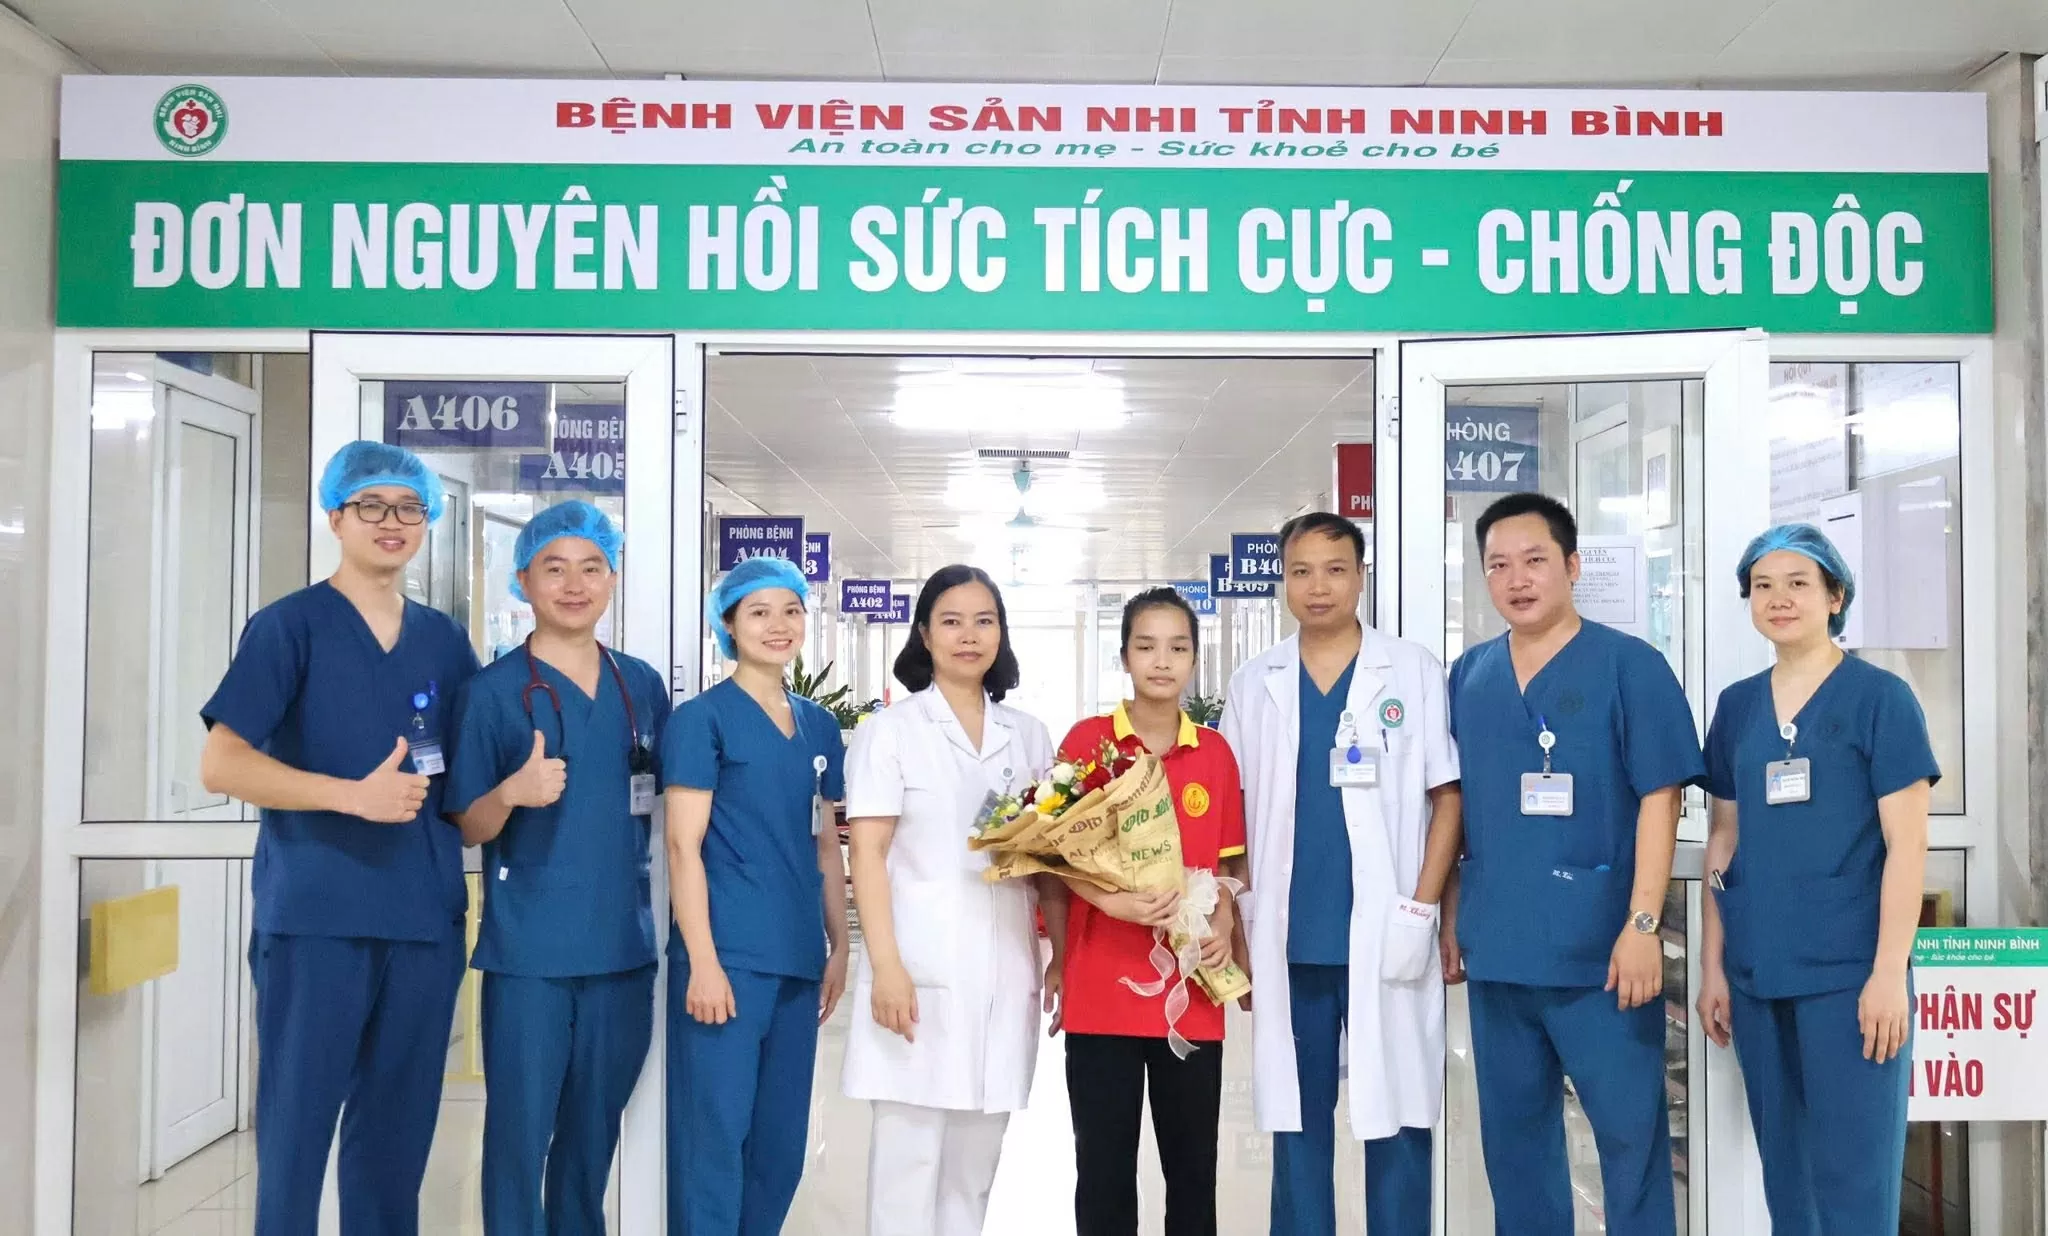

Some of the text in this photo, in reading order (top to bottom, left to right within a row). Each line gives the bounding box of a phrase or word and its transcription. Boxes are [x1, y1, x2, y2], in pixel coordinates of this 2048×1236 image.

[558, 97, 1723, 136] BỆNH VIỆN SẢN NHI TỈNH NINH BÌNH
[787, 138, 844, 154] An
[861, 137, 949, 154] toàn
[970, 140, 1041, 156] cho
[1055, 143, 1116, 158] mẹ
[1158, 140, 1234, 157] Sức
[1249, 142, 1348, 158] khoẻ
[1362, 143, 1437, 158] cho
[1451, 142, 1501, 159] bé
[131, 176, 1924, 315] ĐƠN NGUYÊN HỒI SỨC TÍCH CỰC - CHỐNG ĐỘC
[396, 394, 520, 432] A406
[555, 415, 625, 444] ÒNG BỆ
[1446, 416, 1511, 442] HÒNG
[540, 451, 625, 479] A405
[729, 525, 794, 542] PHÒNG BỆNH
[1247, 540, 1281, 554] PHÒN
[1240, 558, 1283, 575] B40
[849, 597, 884, 608] A402
[1130, 840, 1171, 861] NEWS
[1917, 936, 2040, 950] NHI TỈNH NINH BÌNH
[1993, 989, 2036, 1039] SỰ
[1925, 1052, 1984, 1097] VÀO
